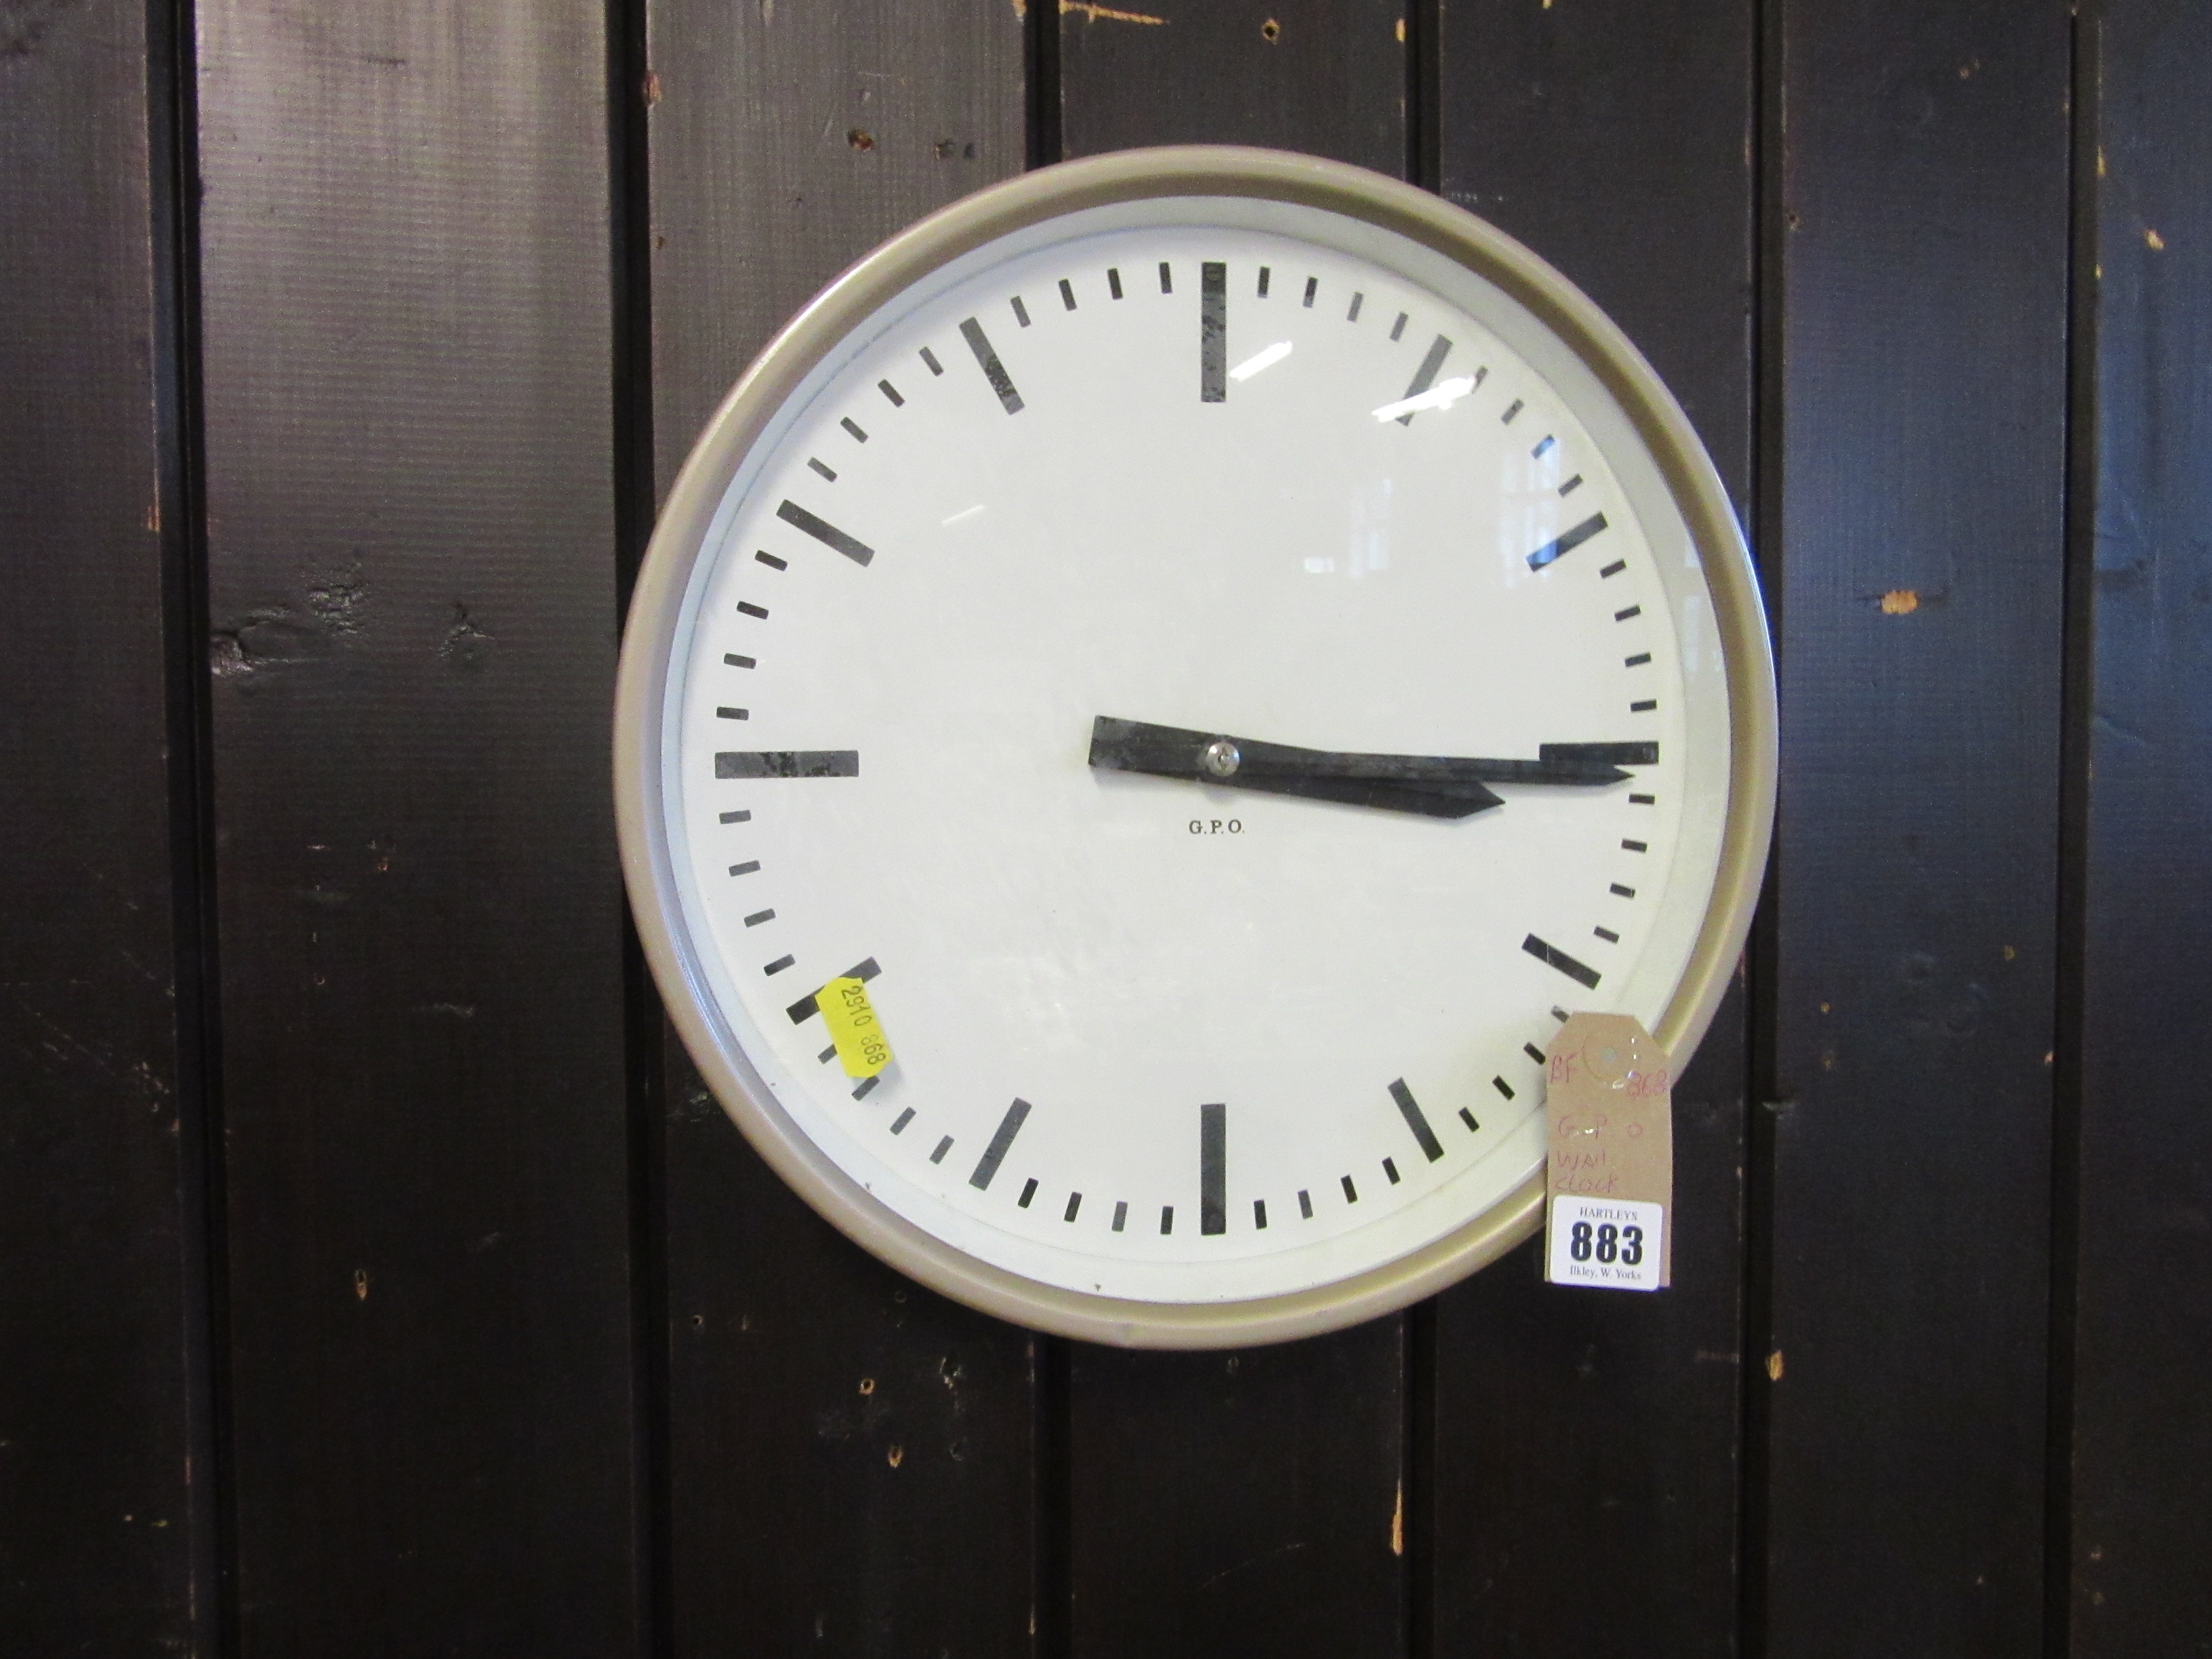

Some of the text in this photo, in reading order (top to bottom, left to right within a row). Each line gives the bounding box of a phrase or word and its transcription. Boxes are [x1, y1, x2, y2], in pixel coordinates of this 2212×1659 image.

[1189, 819, 1245, 834] G.P.O.
[841, 985, 886, 1065] 2910 868
[1580, 1207, 1638, 1221] HARTLEYS
[1570, 1221, 1643, 1265] 883
[1616, 1268, 1641, 1279] Yorks
